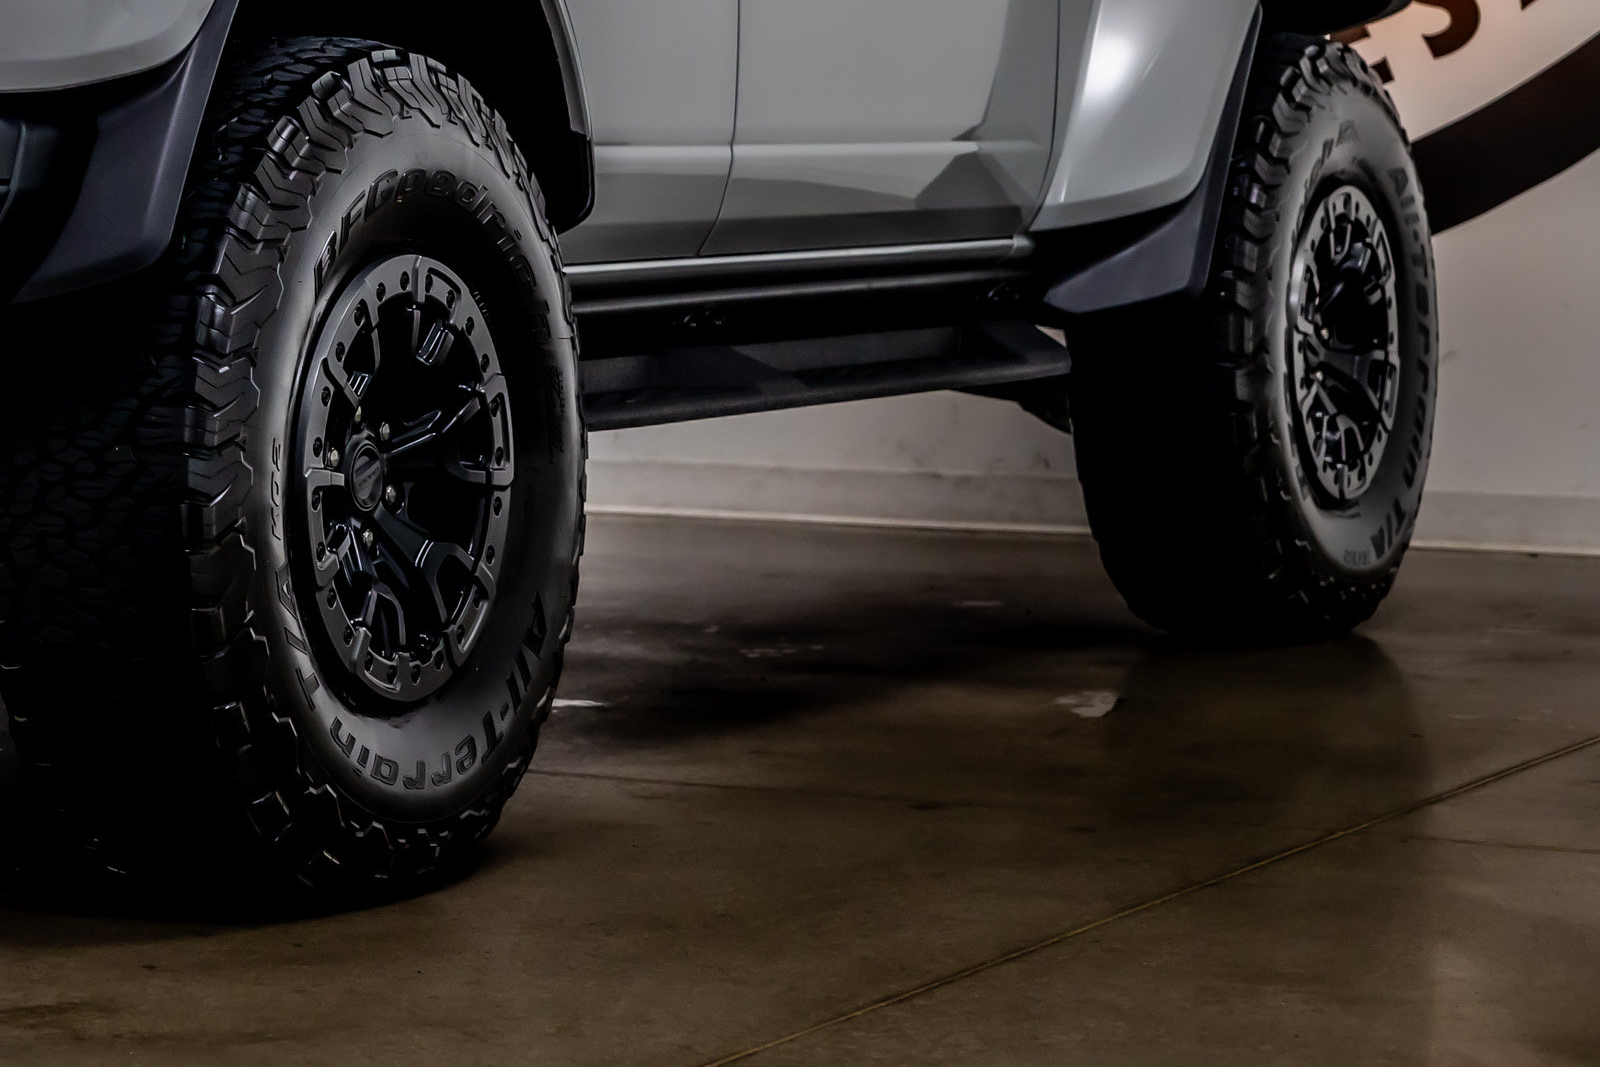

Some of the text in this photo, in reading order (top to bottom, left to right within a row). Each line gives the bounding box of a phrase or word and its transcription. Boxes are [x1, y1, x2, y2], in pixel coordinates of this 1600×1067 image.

[314, 168, 551, 343] BFGoodrich
[275, 559, 320, 712] T/A
[329, 591, 547, 790] All-Terrain
